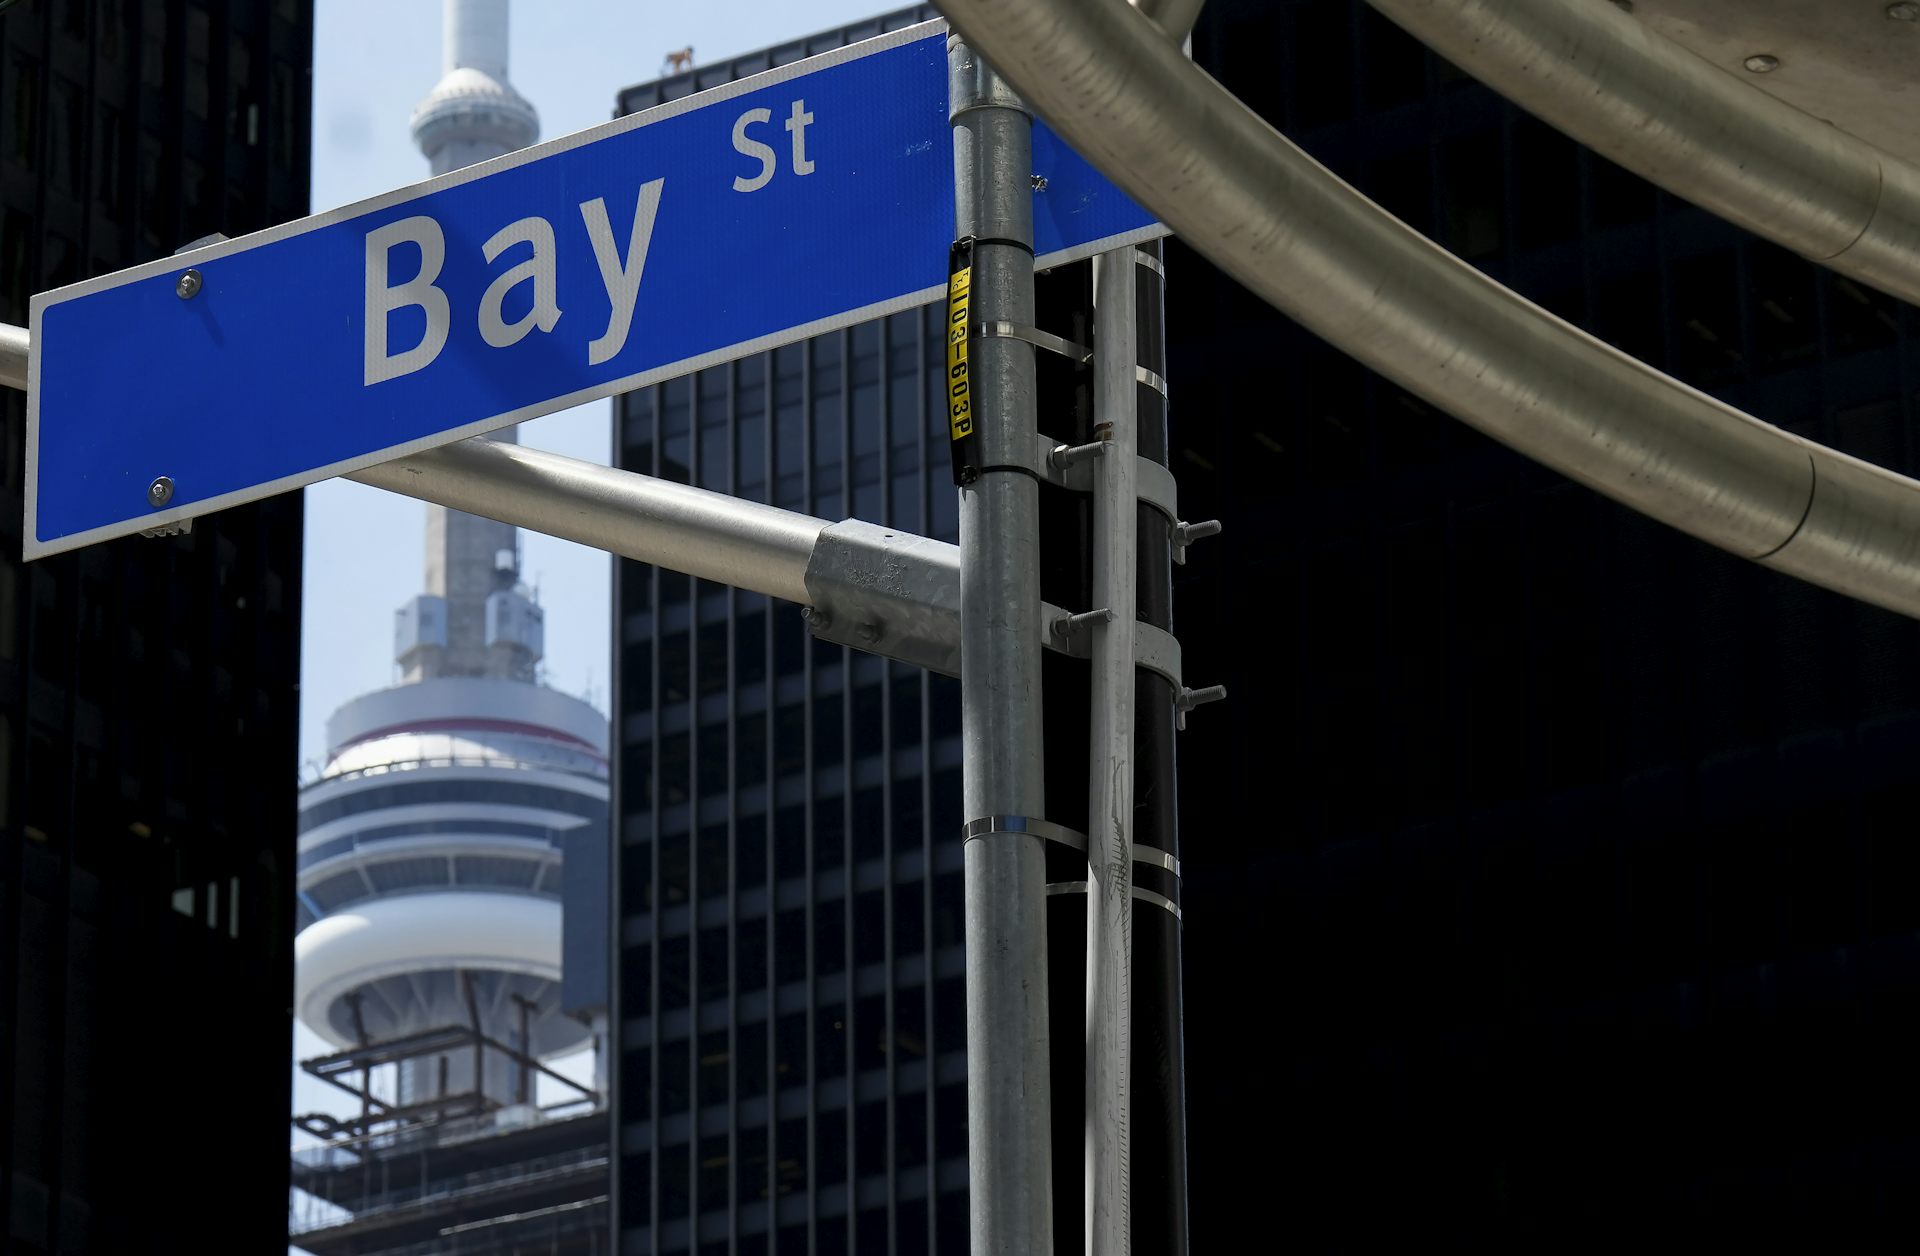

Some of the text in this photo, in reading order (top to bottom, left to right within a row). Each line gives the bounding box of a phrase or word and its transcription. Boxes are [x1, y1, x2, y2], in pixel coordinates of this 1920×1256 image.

[364, 99, 815, 387] Bay St
[952, 270, 969, 291] TTC
[951, 293, 971, 435] 103-603P
